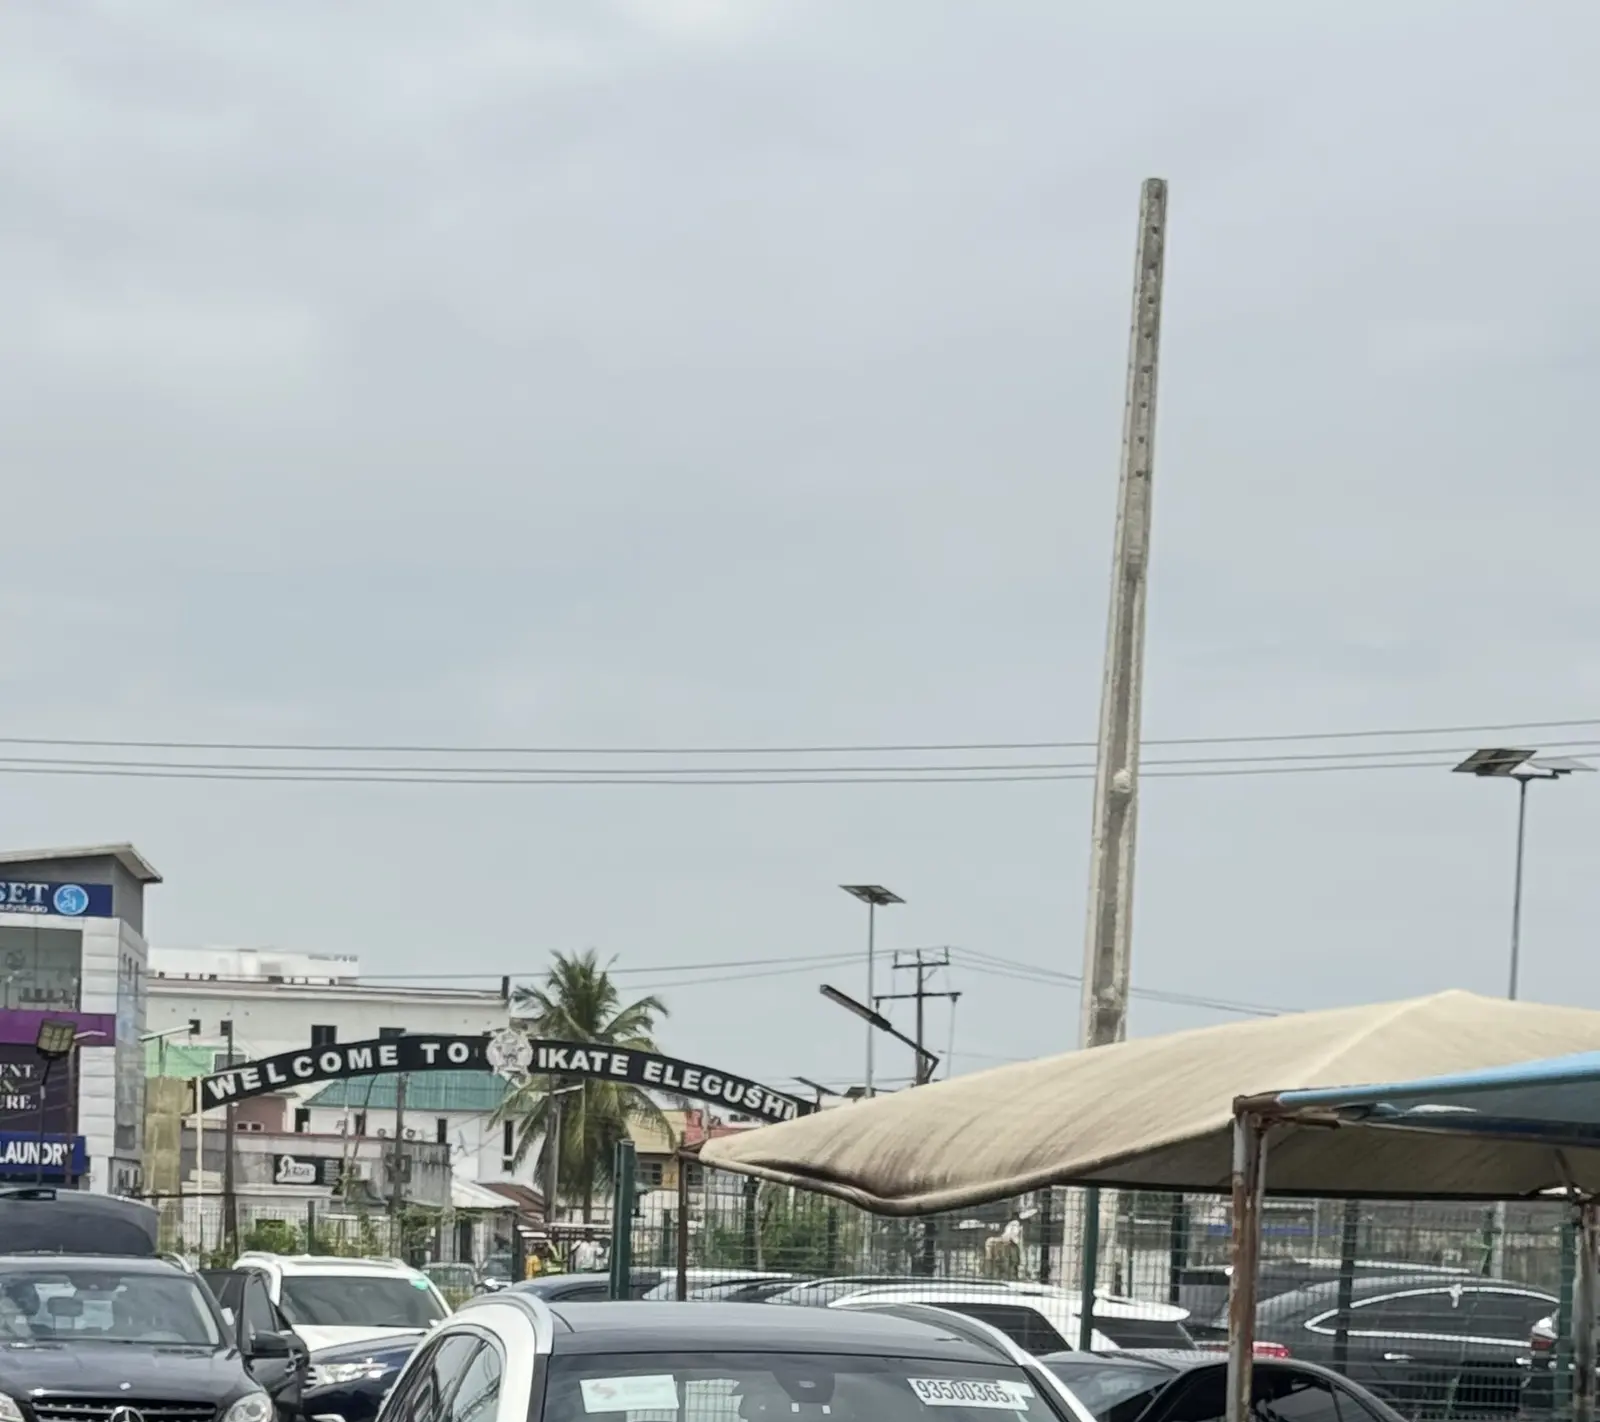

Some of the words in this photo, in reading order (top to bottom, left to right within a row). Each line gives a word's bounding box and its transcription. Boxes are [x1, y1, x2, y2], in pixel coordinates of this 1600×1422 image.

[207, 1045, 399, 1100] WELCOME
[420, 1042, 469, 1065] TO
[538, 1048, 630, 1076] IKATE
[643, 1060, 798, 1121] ELEGUSHI
